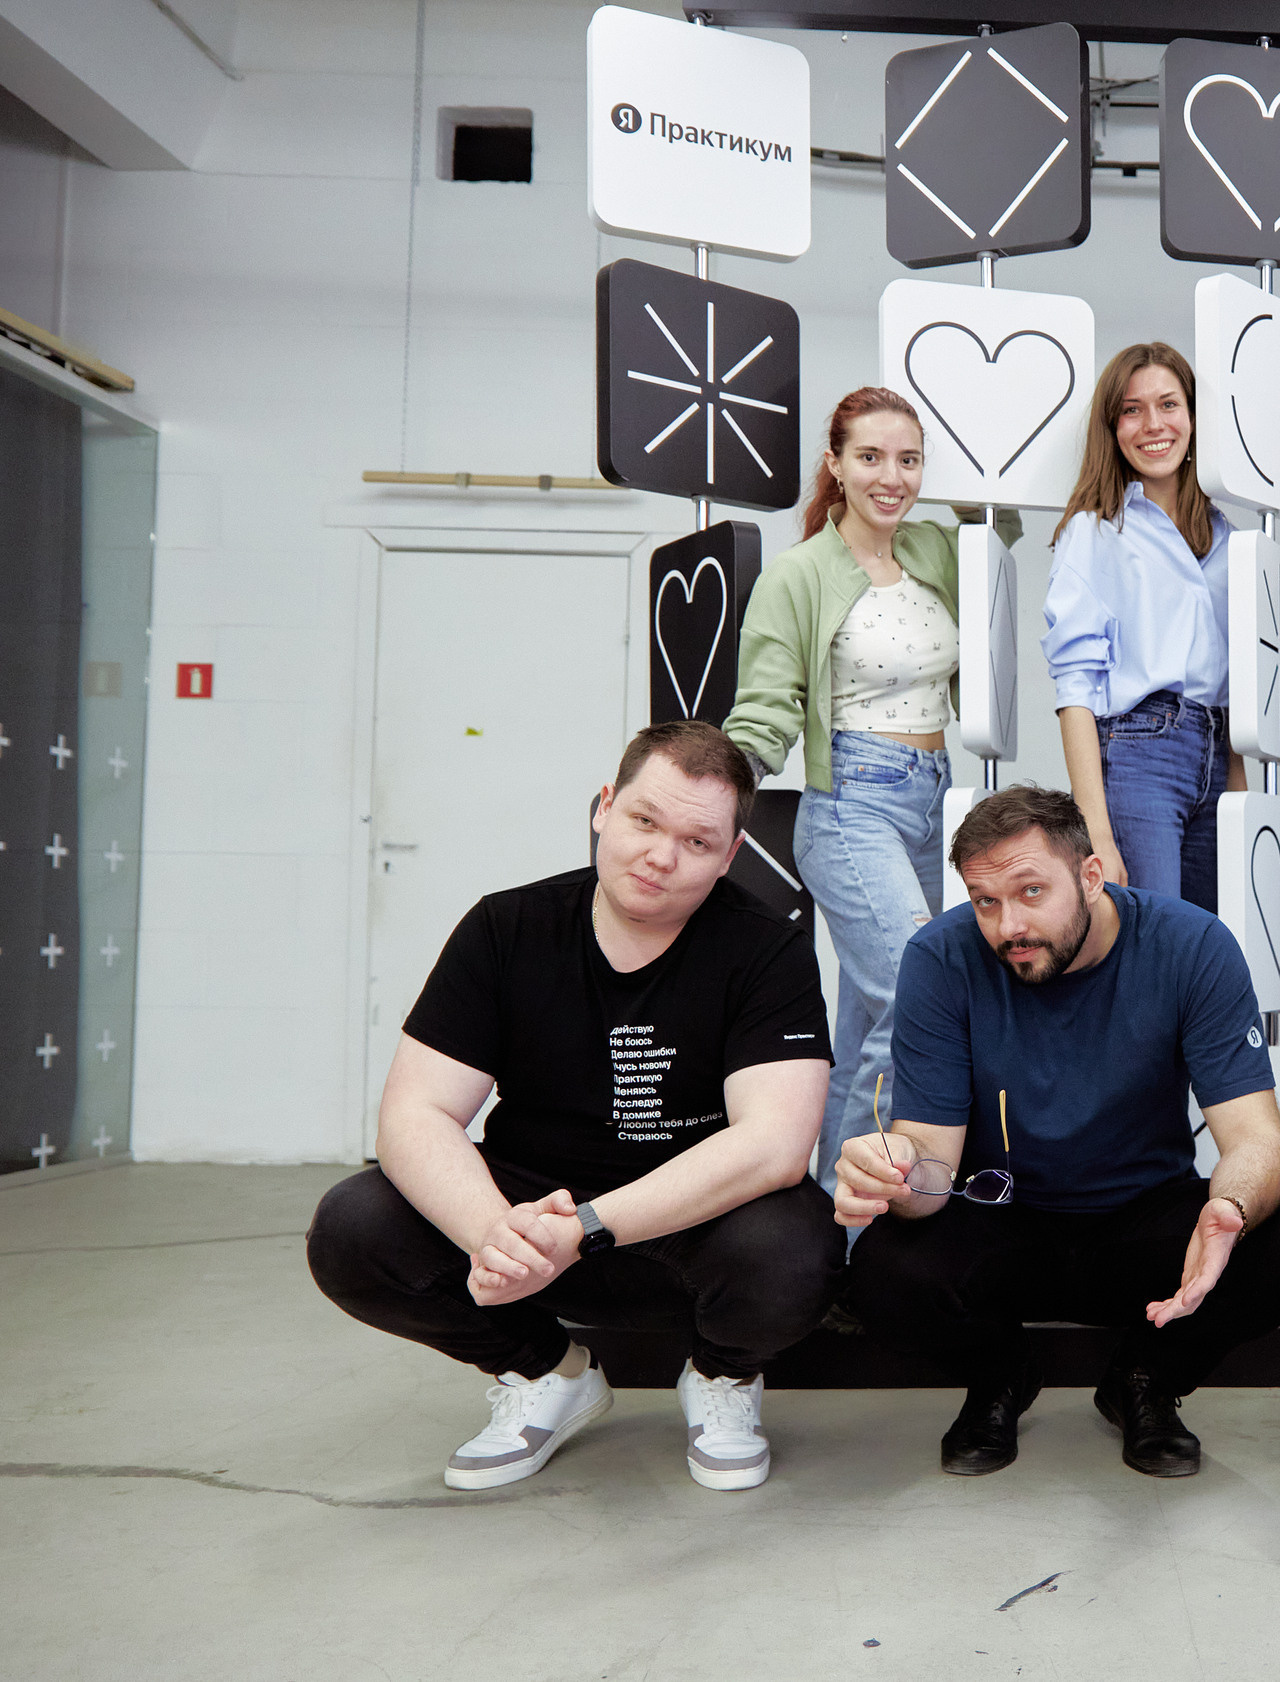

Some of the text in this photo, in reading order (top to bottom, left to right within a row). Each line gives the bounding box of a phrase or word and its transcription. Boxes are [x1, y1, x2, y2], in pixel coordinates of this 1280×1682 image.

[650, 112, 792, 162] Практикум
[610, 1038, 653, 1046] Не боюсь
[611, 1047, 677, 1060] Делаю ошибки
[639, 1061, 671, 1070] новому
[613, 1098, 663, 1108] Исследую
[613, 1110, 661, 1120] В домике
[618, 1112, 723, 1129] Люблю тебя до слез
[618, 1132, 673, 1142] Стараюсь
